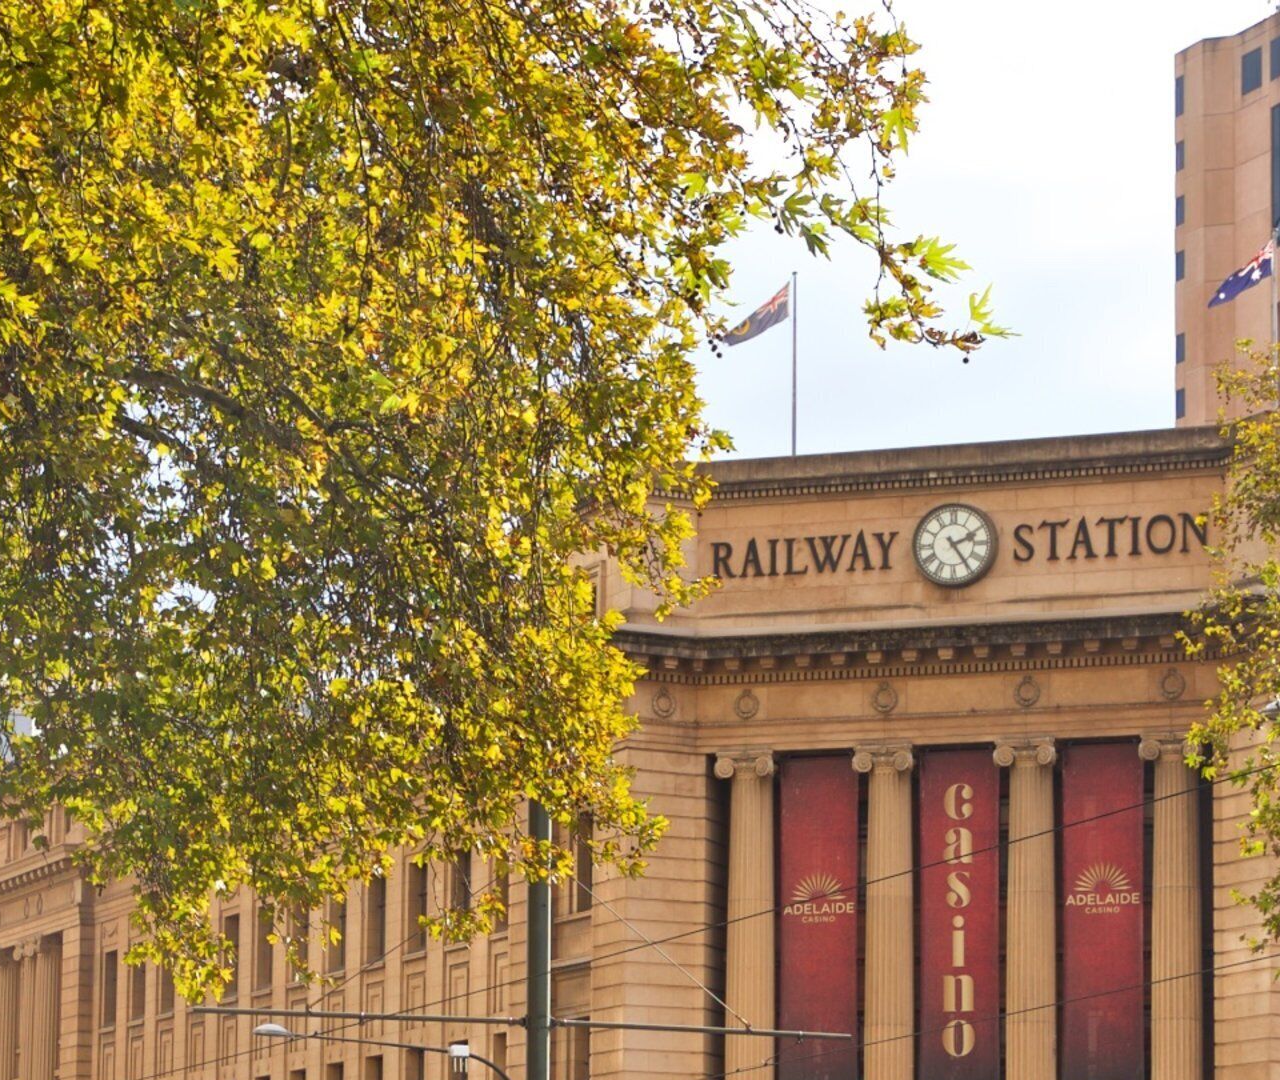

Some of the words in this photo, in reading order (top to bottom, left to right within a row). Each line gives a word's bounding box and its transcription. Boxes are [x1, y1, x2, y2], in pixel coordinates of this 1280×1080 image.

[710, 529, 900, 579] RAILWAY
[1013, 511, 1210, 562] STATION
[1065, 891, 1141, 908] ADELAIDE
[783, 900, 856, 916] ADELAIDE
[1084, 906, 1121, 915] CASINO
[801, 914, 837, 924] CASINO
